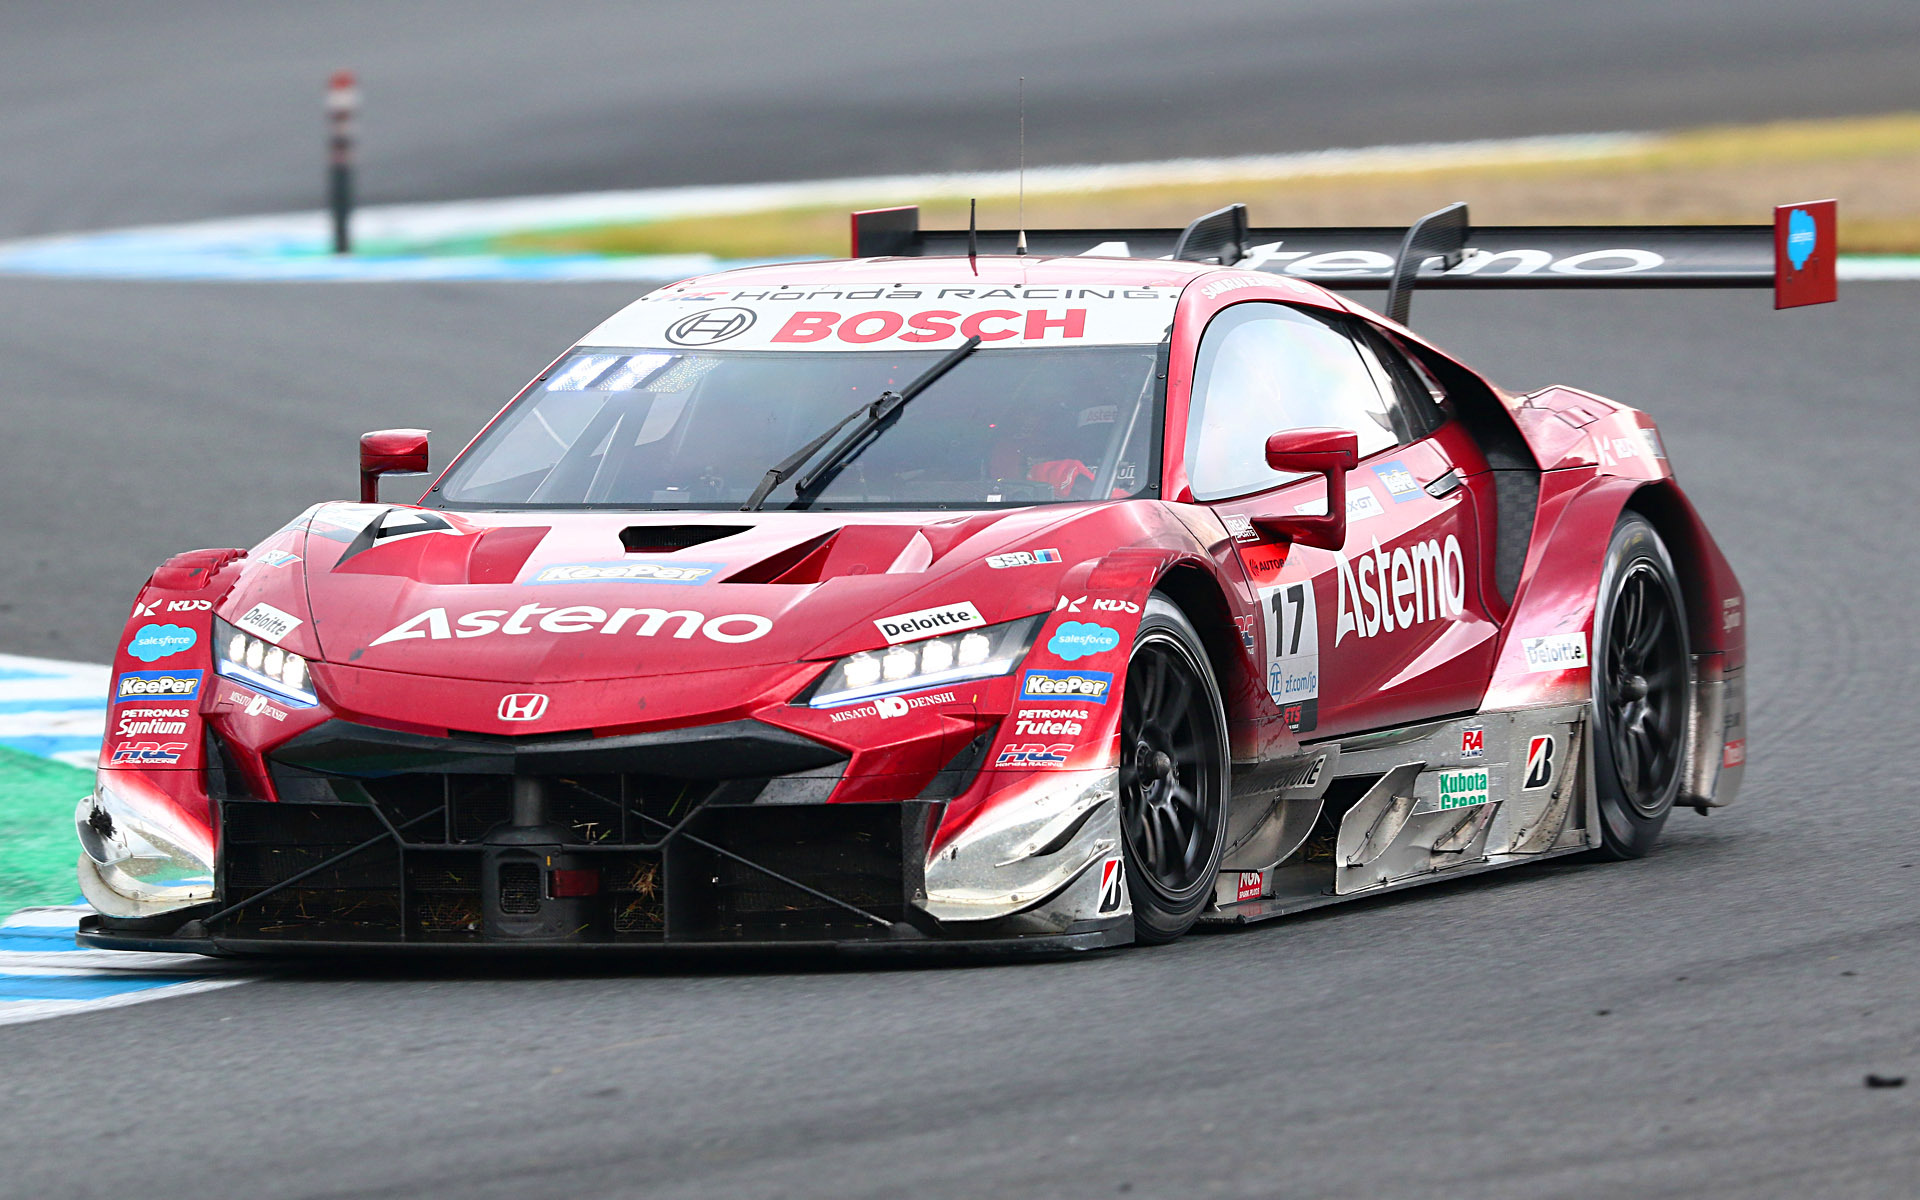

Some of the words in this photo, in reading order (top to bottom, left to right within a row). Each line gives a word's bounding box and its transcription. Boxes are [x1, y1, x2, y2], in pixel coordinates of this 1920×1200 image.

[731, 288, 922, 301] Honda
[937, 289, 1159, 300] RACING
[770, 309, 1087, 344] BOSCH
[540, 565, 712, 581] KeePer
[1335, 534, 1466, 648] Astemo
[368, 602, 773, 647] Astemo
[1271, 583, 1305, 658] 17
[138, 635, 191, 647] salesforce
[1058, 633, 1113, 646] salesforce
[120, 677, 198, 696] KeePer
[1026, 676, 1107, 696] KeePer
[1285, 671, 1317, 693] zf.com/jp
[121, 708, 190, 718] PETRONAS
[829, 706, 877, 723] MISATO
[907, 691, 957, 709] DENSHI
[1017, 709, 1089, 720] PETRONAS
[115, 718, 187, 738] Syntium
[1015, 719, 1083, 736] Tutela
[111, 741, 189, 761] HRC
[996, 742, 1075, 763] HRC
[1440, 772, 1488, 794] Kubota
